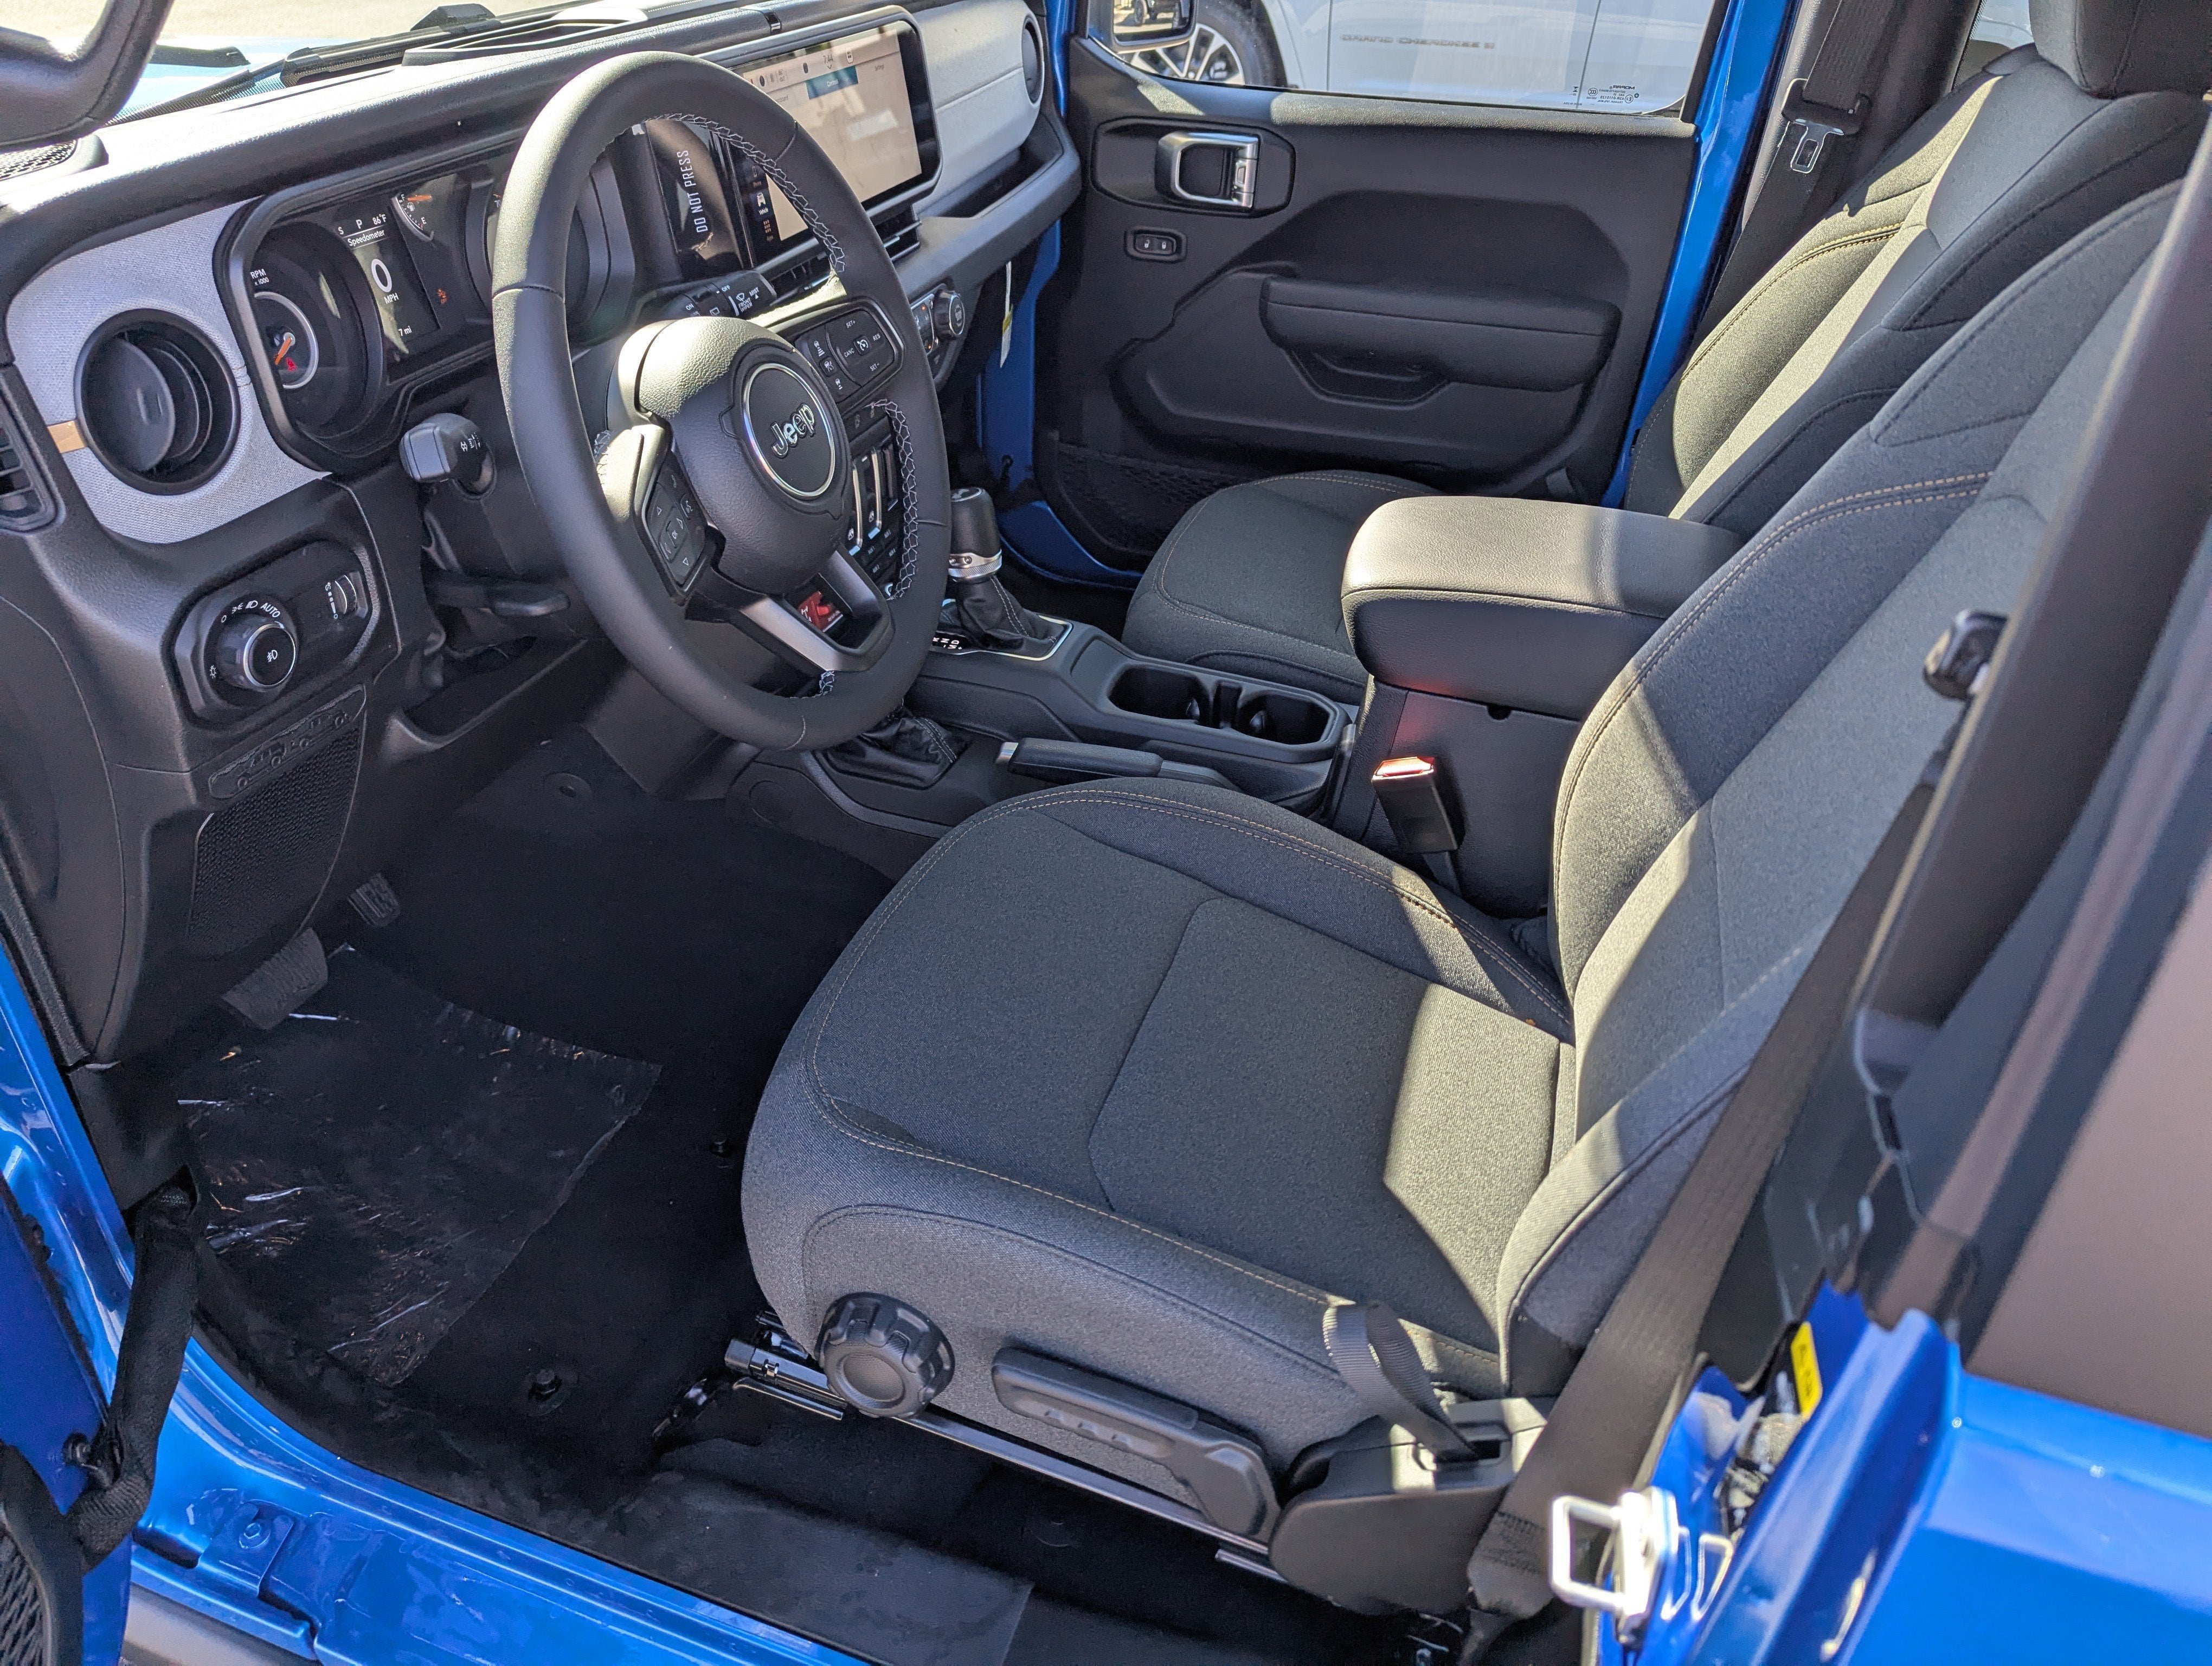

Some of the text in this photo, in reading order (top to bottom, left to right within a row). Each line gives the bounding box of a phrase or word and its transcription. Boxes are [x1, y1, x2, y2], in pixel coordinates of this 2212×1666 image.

[677, 150, 708, 233] DO NOT PRESS
[356, 219, 363, 229] P
[348, 229, 385, 247] Speedometer
[250, 268, 267, 279] RPM
[371, 258, 393, 293] 0
[749, 287, 760, 297] MIST
[384, 292, 400, 304] MPH
[738, 297, 751, 309] FRONT
[685, 303, 695, 311] ON
[398, 325, 413, 336] 7 mi
[872, 333, 881, 341] RES
[844, 348, 854, 358] CANC
[770, 403, 815, 457] Jeep
[260, 602, 281, 618] AUTO
